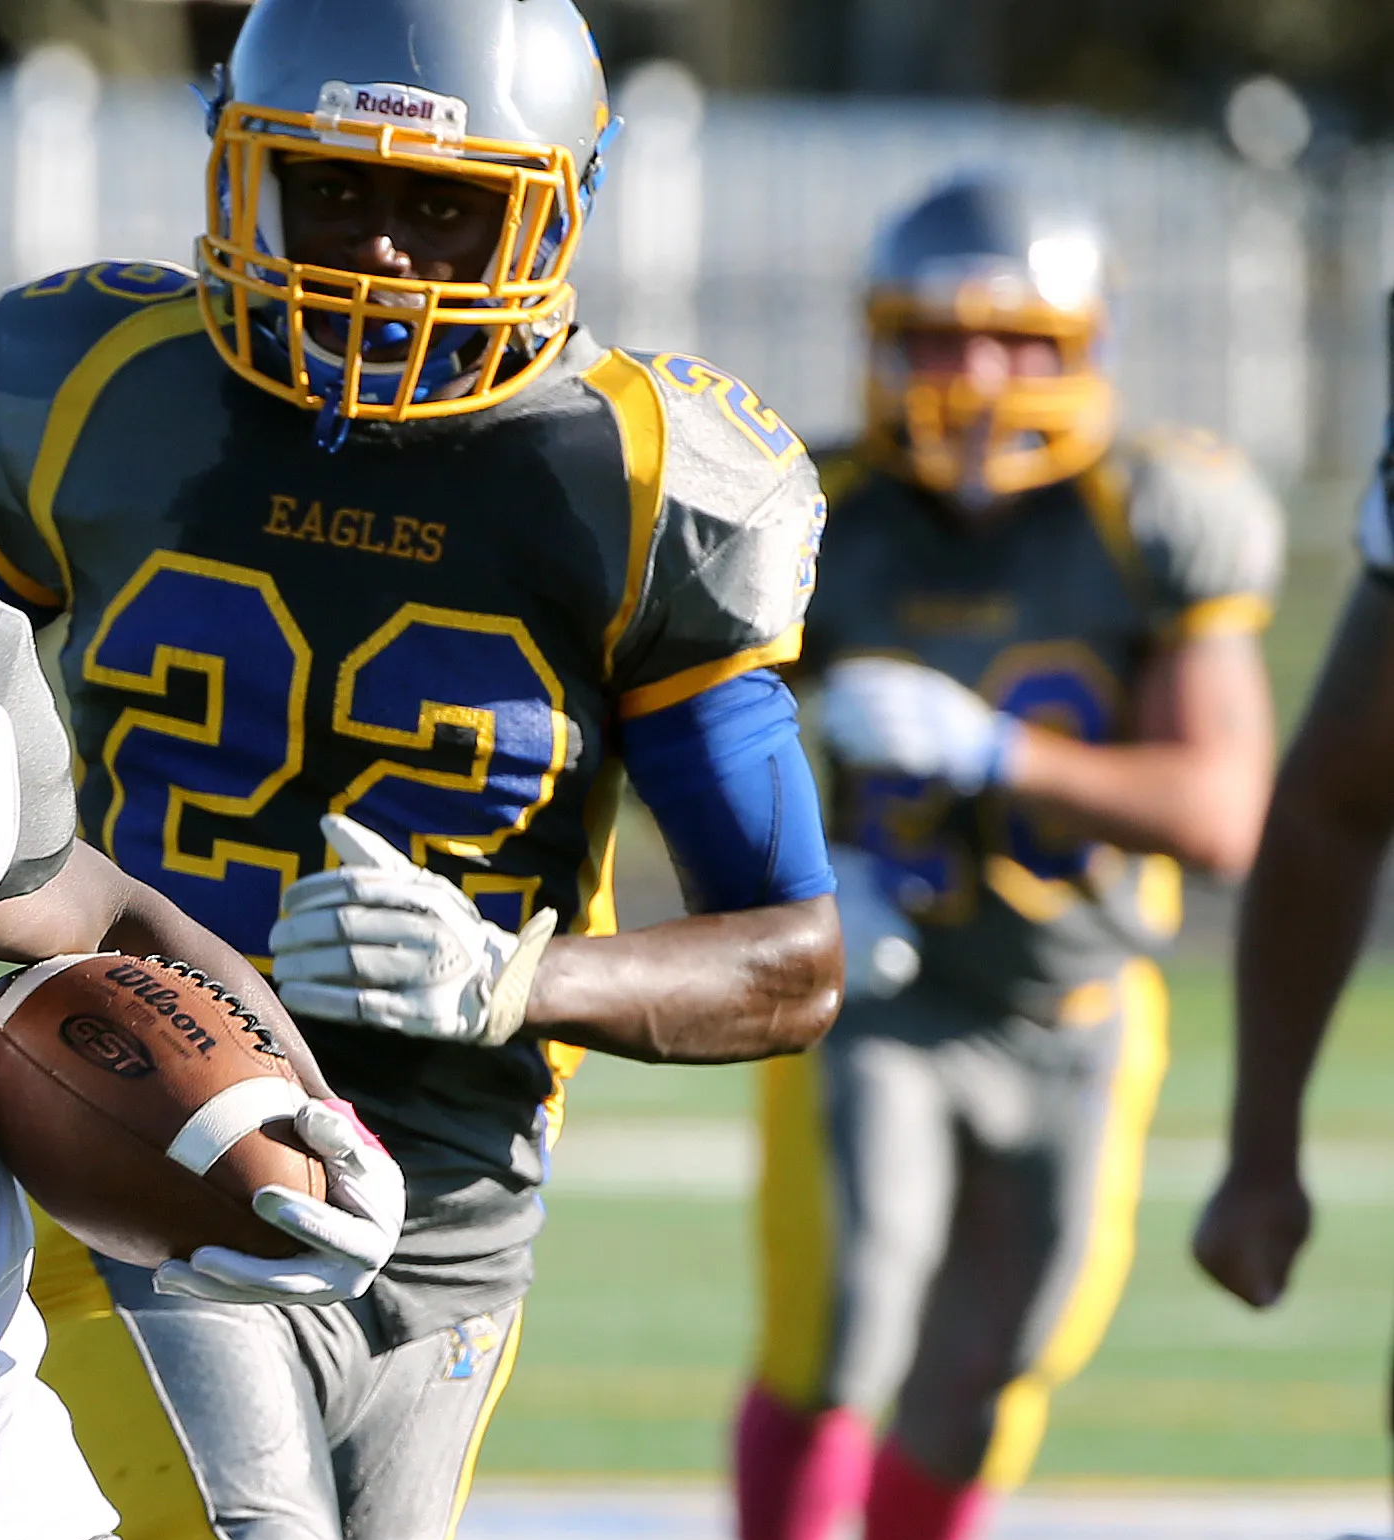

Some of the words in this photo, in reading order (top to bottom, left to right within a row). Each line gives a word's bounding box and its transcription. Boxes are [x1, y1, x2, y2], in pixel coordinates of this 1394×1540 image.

[355, 91, 435, 120] Riddell
[263, 493, 448, 564] EAGLES
[82, 548, 564, 978] 22
[105, 963, 216, 1053] Wilson
[64, 1017, 150, 1074] GST
